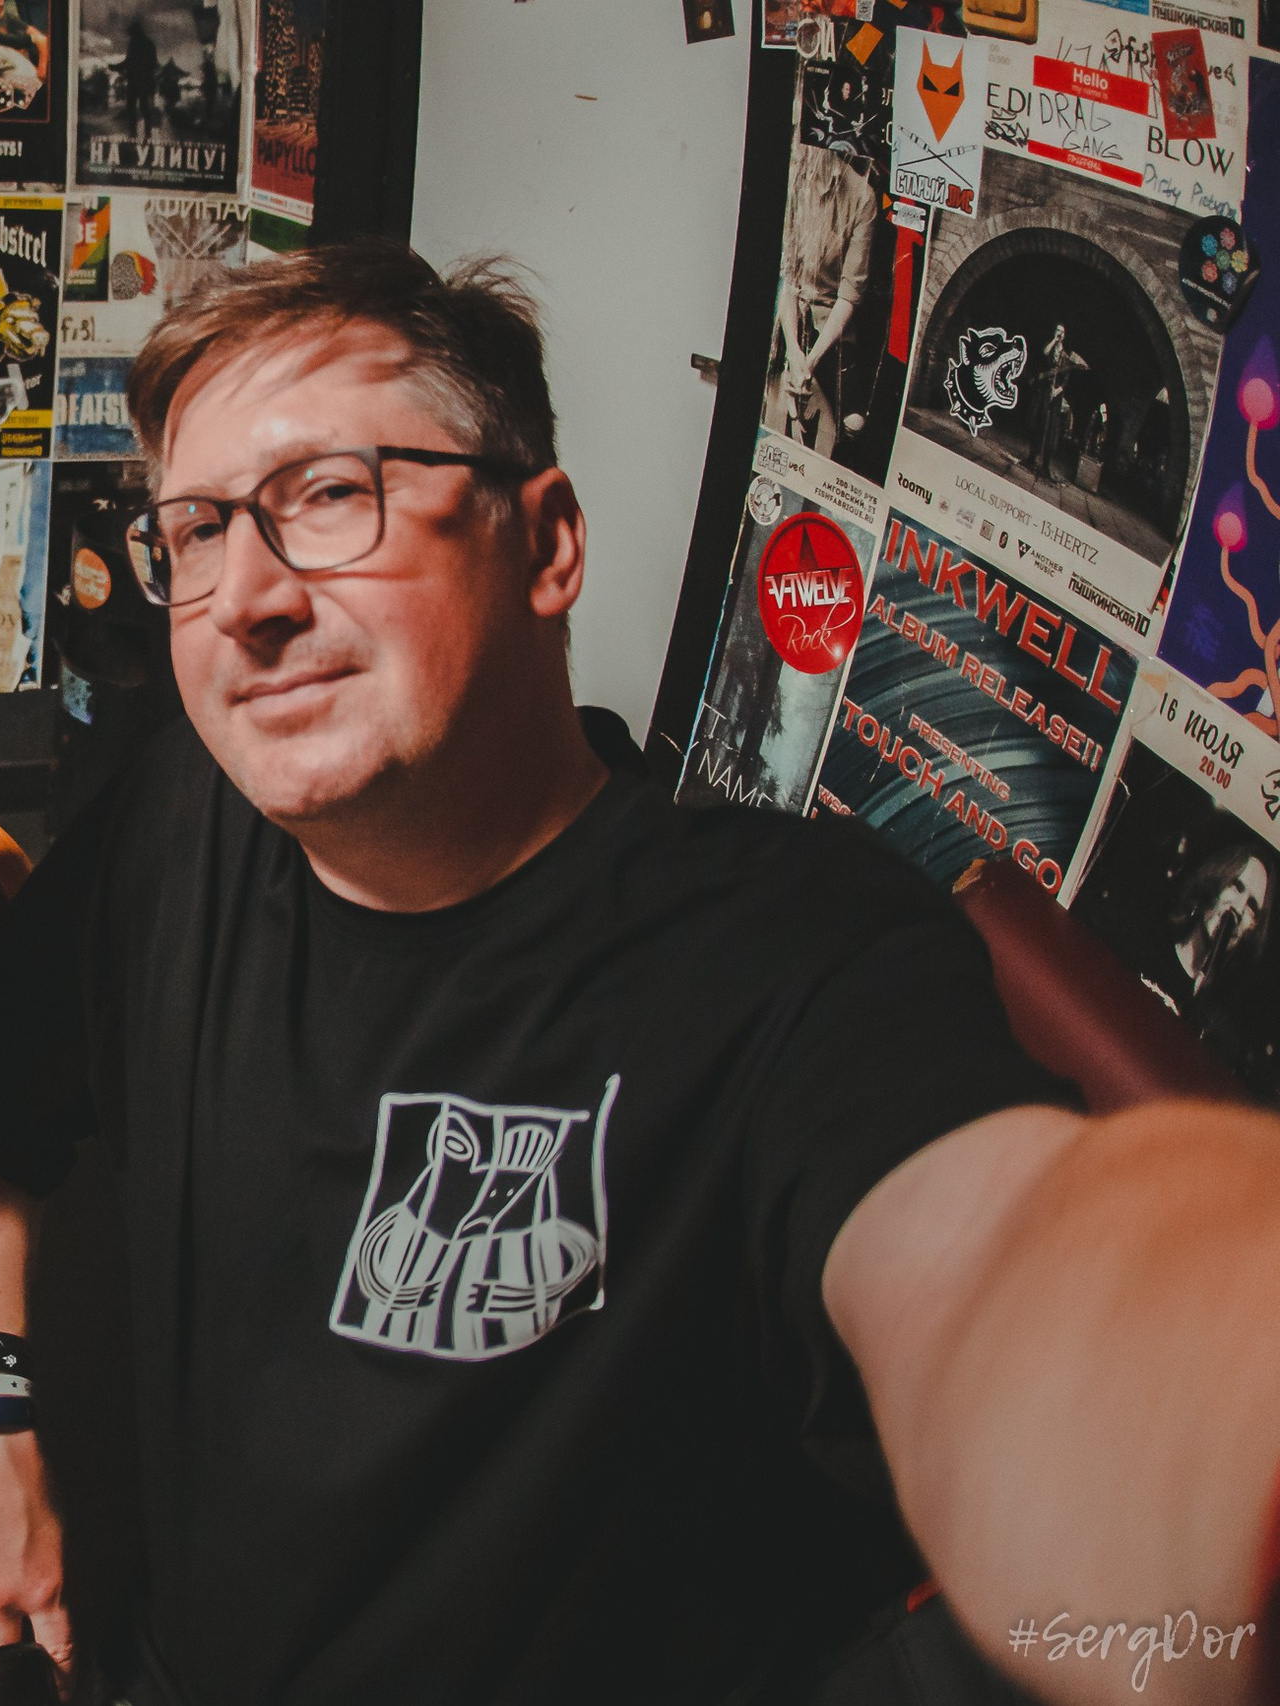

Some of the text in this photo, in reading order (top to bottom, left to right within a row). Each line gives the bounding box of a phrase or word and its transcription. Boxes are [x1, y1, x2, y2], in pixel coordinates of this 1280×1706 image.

[1072, 67, 1109, 91] Hello
[1039, 91, 1112, 132] DRAG
[1061, 129, 1124, 161] GANG
[1147, 125, 1235, 178] BLOW
[895, 168, 947, 205] СТАРЫЙ
[1143, 162, 1182, 206] Dirty
[814, 487, 875, 525] FISHFABRIQUE.RU
[955, 475, 987, 502] LOCAL
[989, 495, 1033, 528] SUPPORT
[1040, 519, 1100, 566] 13:HERTZ
[1030, 550, 1064, 574] ANOTHER
[1034, 560, 1055, 578] MUSIC
[777, 596, 857, 656] Rock
[882, 517, 1122, 716] INKWELL
[867, 593, 1104, 773] ALBUM RELEASE!!
[1159, 691, 1246, 770] 16 ИЮЛЯ
[907, 712, 1012, 803] PRESENTING
[1198, 755, 1233, 790] 20.00
[841, 695, 1064, 896] TOUCH AND GO
